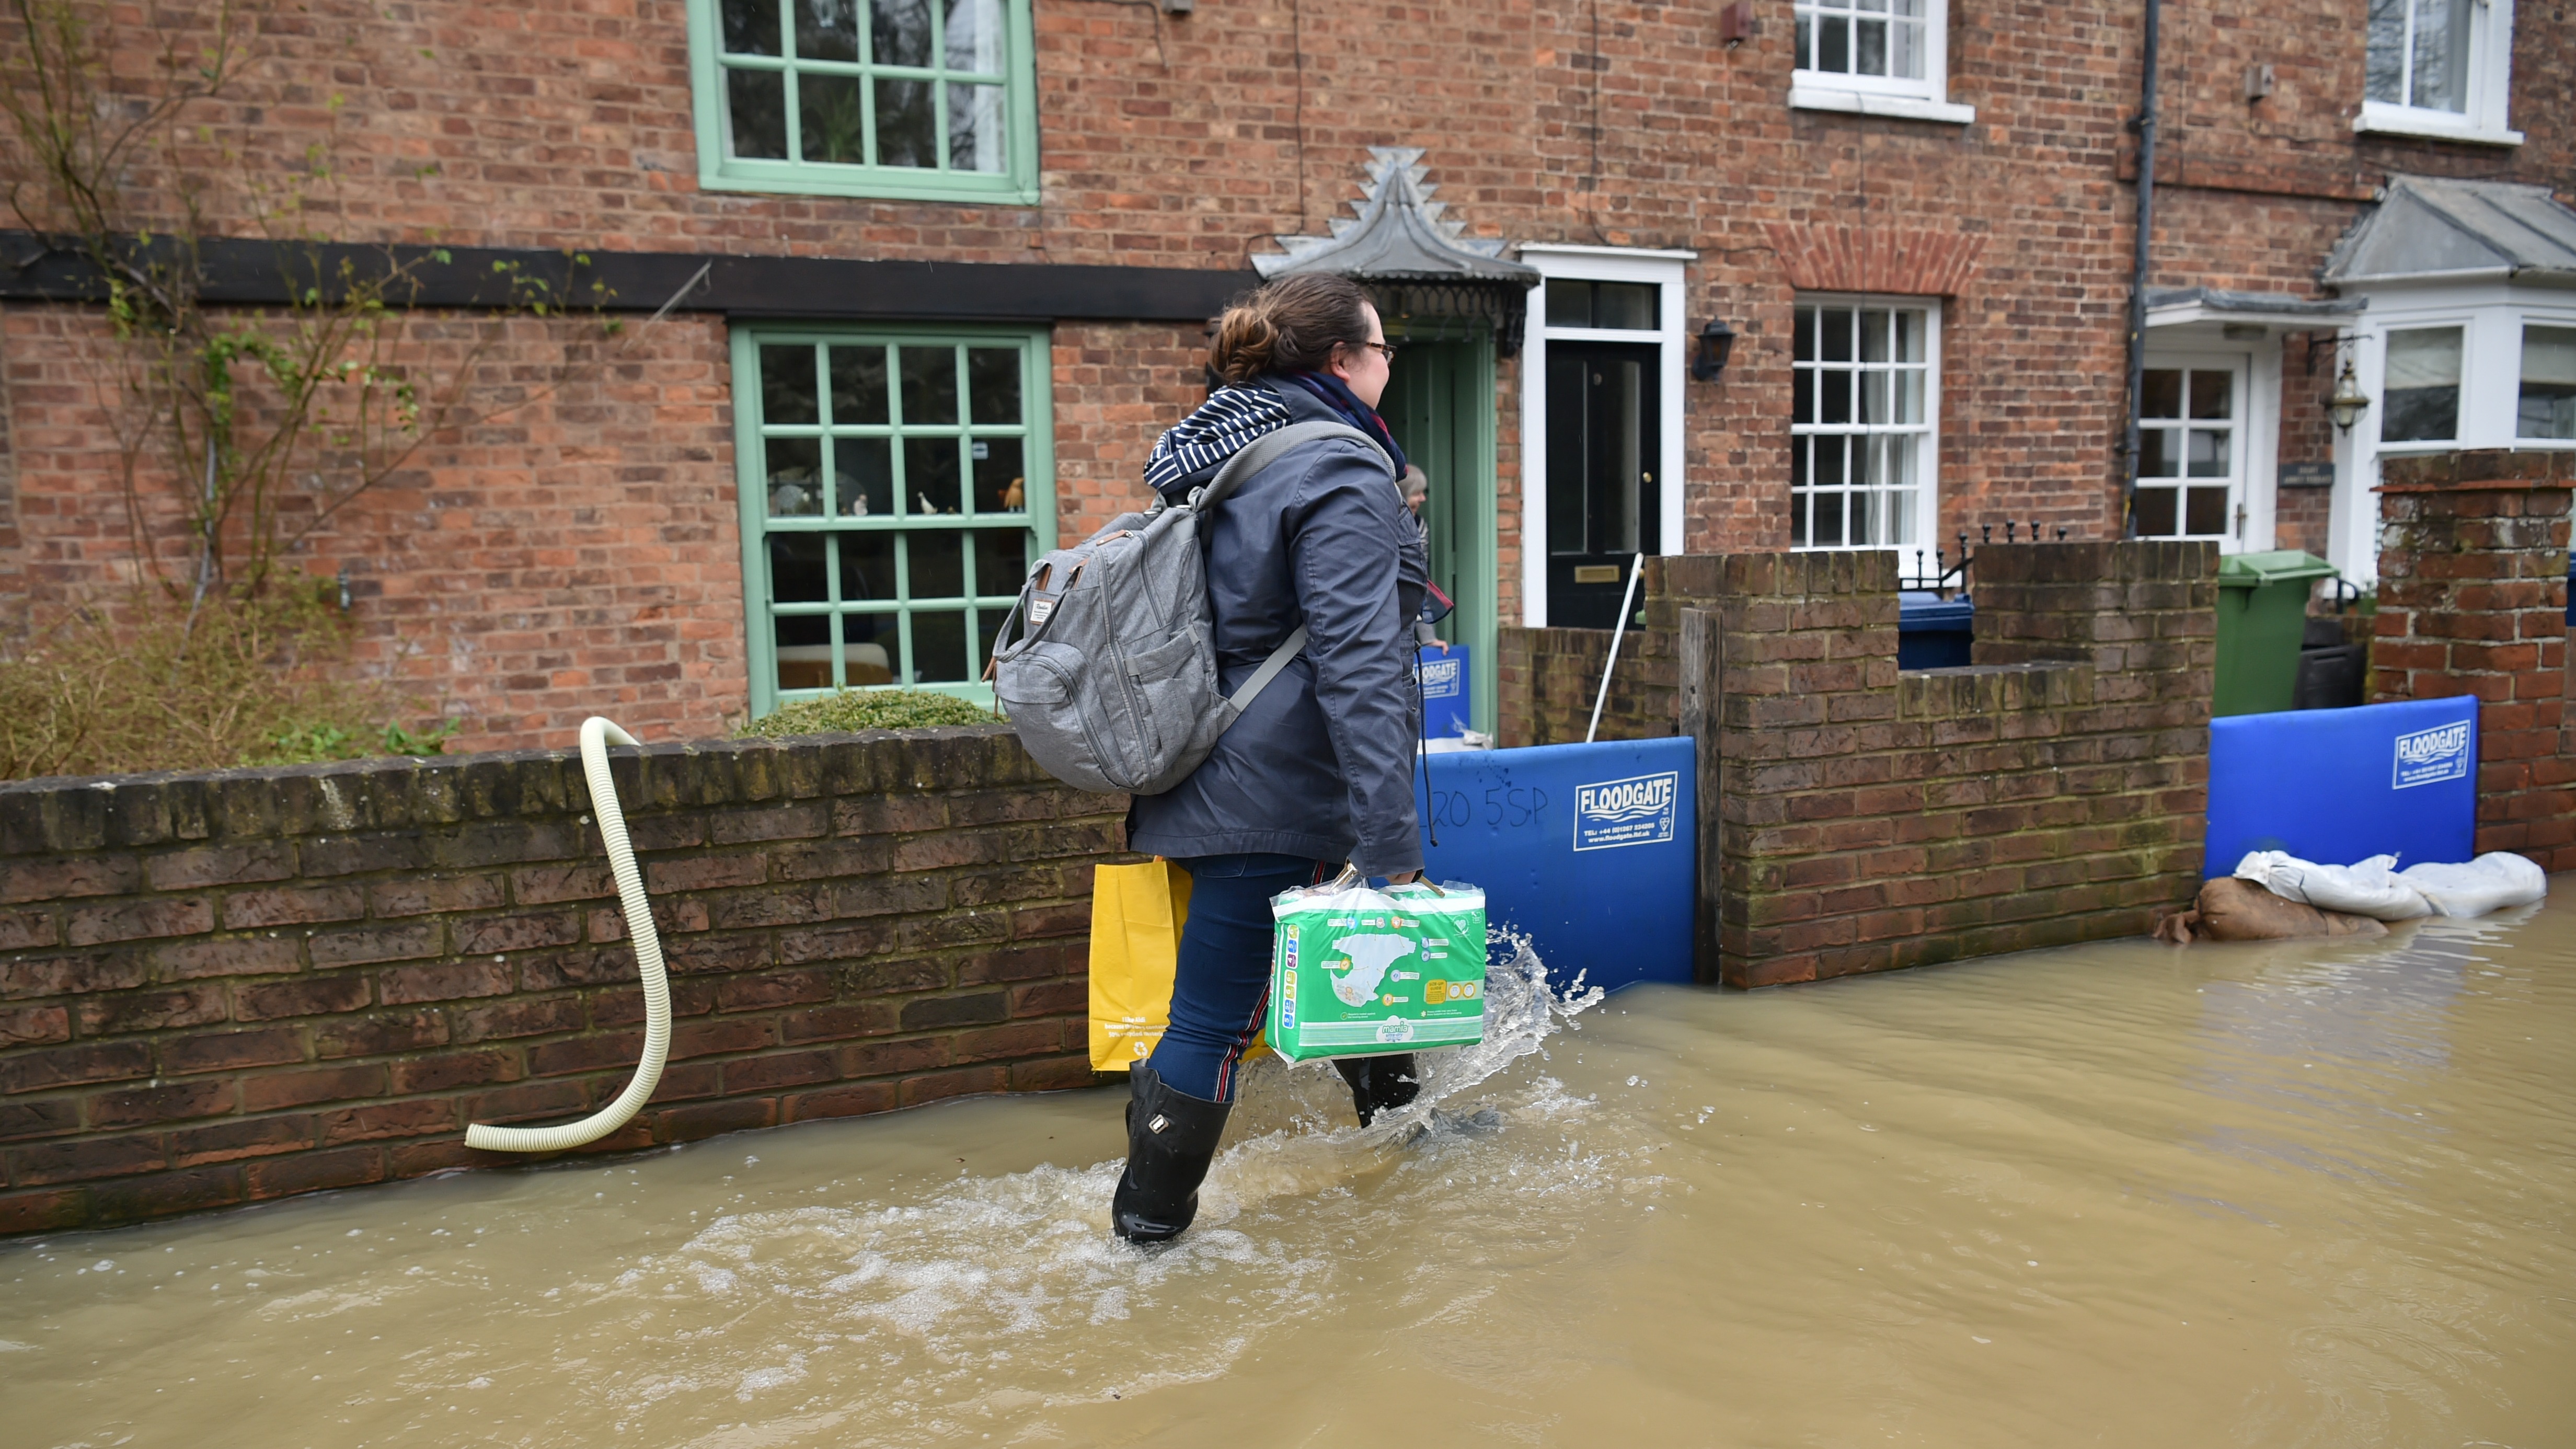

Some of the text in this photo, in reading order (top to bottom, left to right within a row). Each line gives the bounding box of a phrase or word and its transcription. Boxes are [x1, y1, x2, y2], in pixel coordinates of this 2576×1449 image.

[2399, 725, 2466, 759] FLOODGATE
[1581, 778, 1672, 812] FLOODGATE
[1382, 1021, 1408, 1033] mamia
